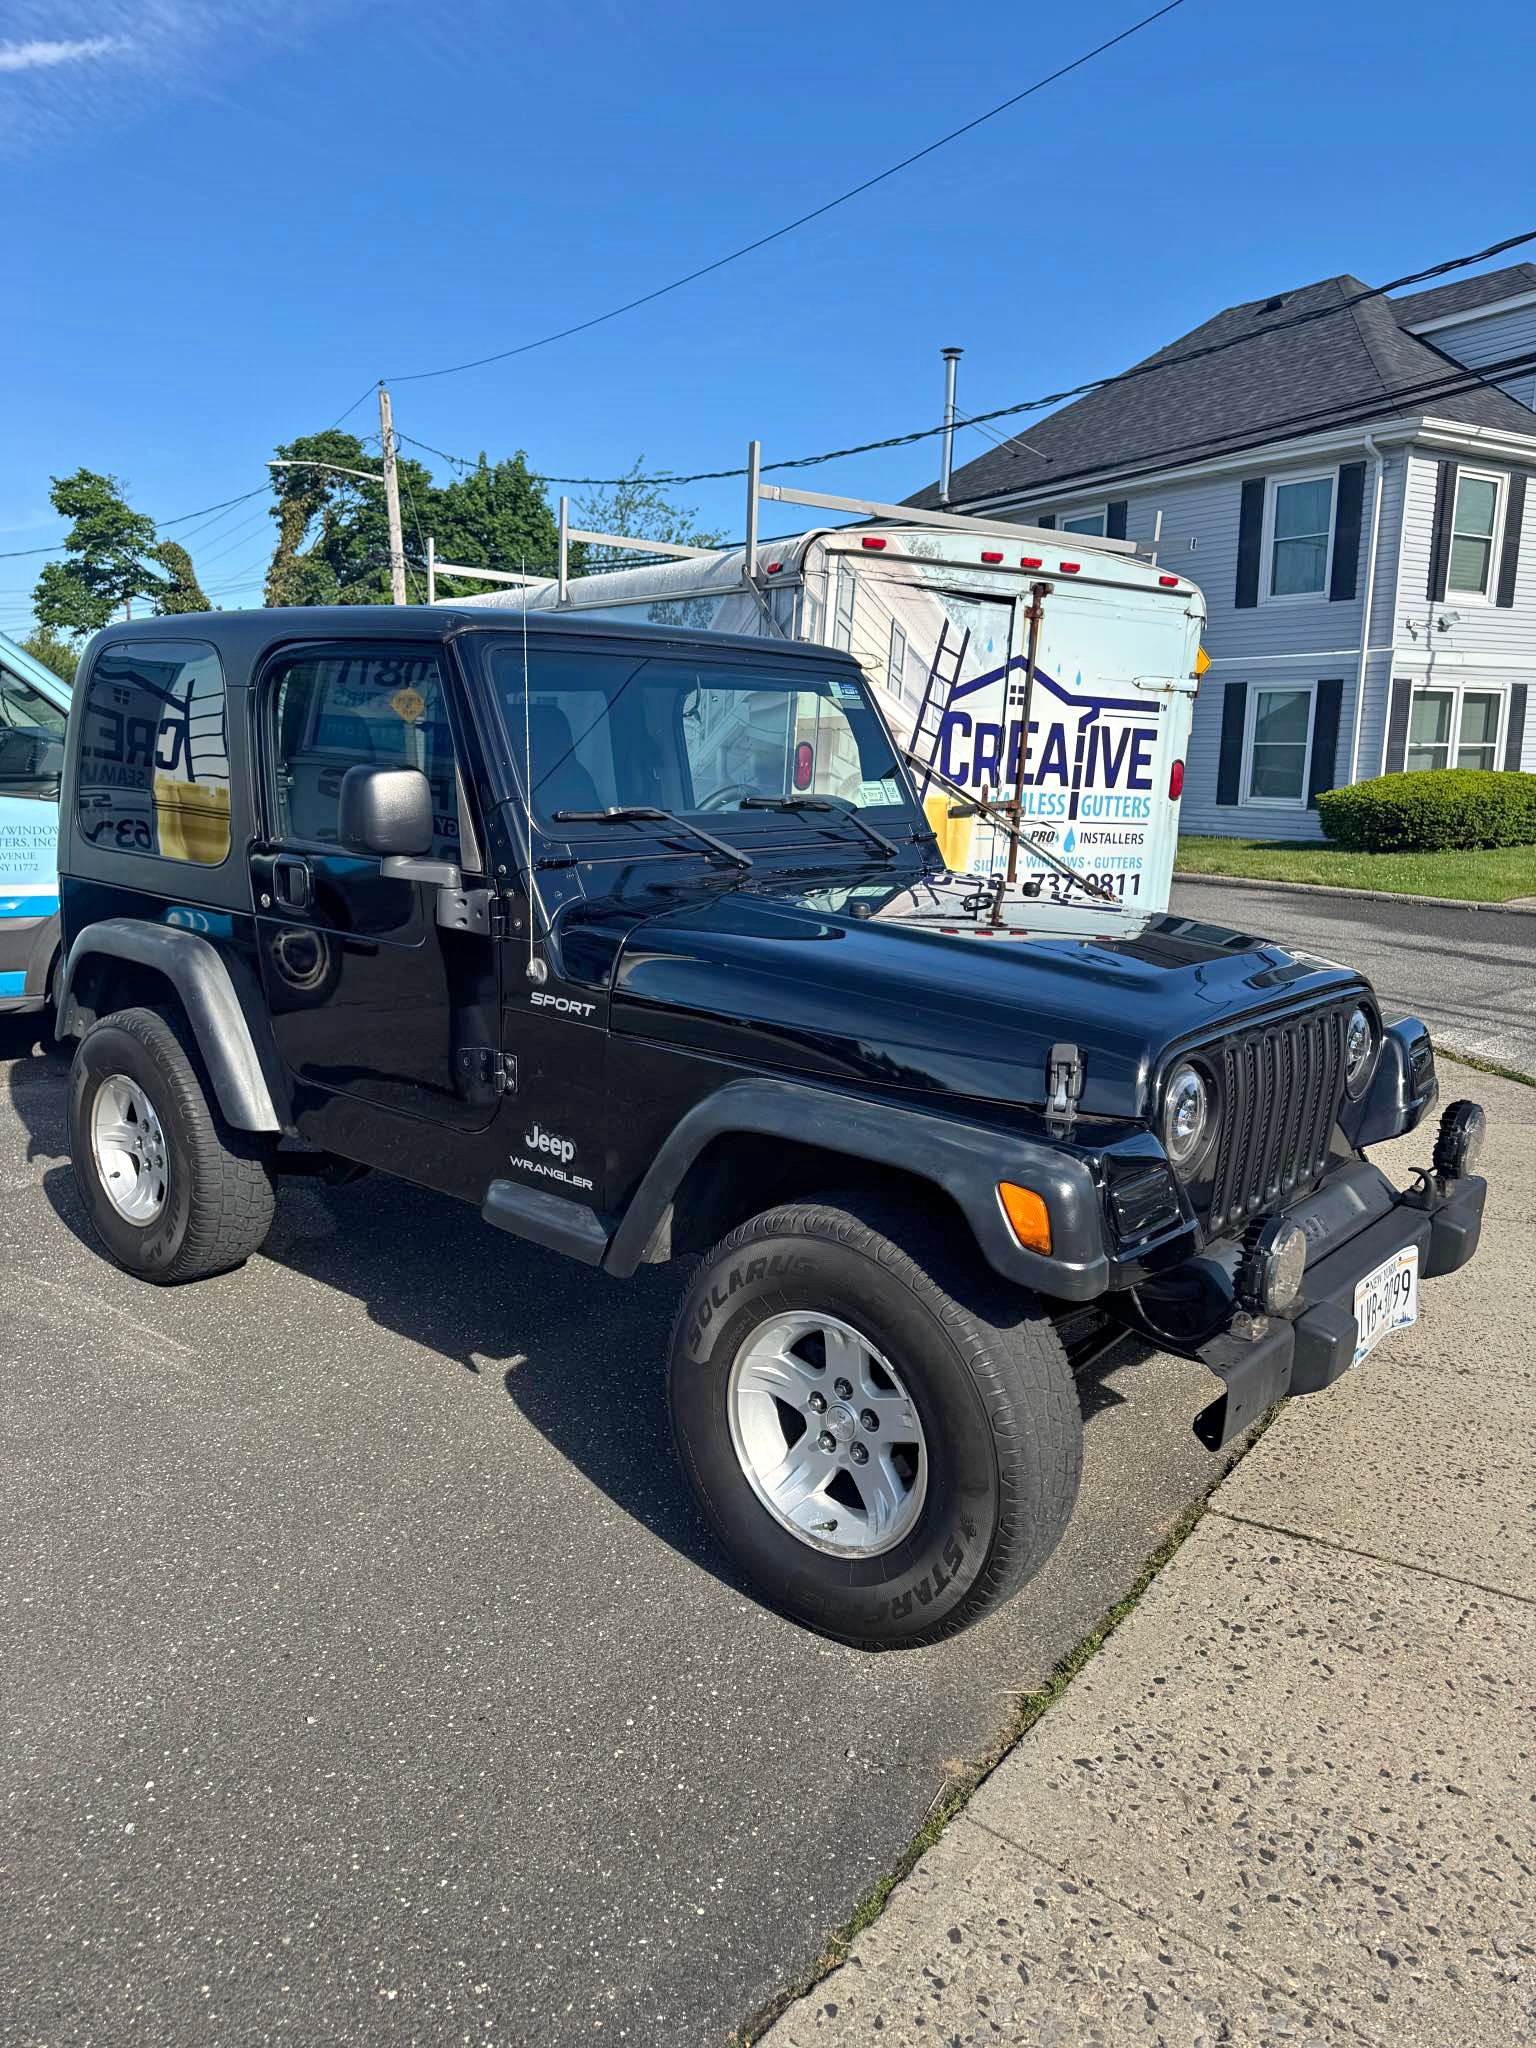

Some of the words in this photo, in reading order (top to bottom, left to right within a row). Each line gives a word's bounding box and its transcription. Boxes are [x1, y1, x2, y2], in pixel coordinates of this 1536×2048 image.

[1081, 795, 1151, 818] GUTTERS
[1080, 832, 1144, 845] INSTALLERS
[1094, 856, 1142, 870] GUTTERS
[530, 991, 596, 1017] SPORT
[525, 1125, 574, 1163] Jeep
[509, 1155, 593, 1191] WRANGLER
